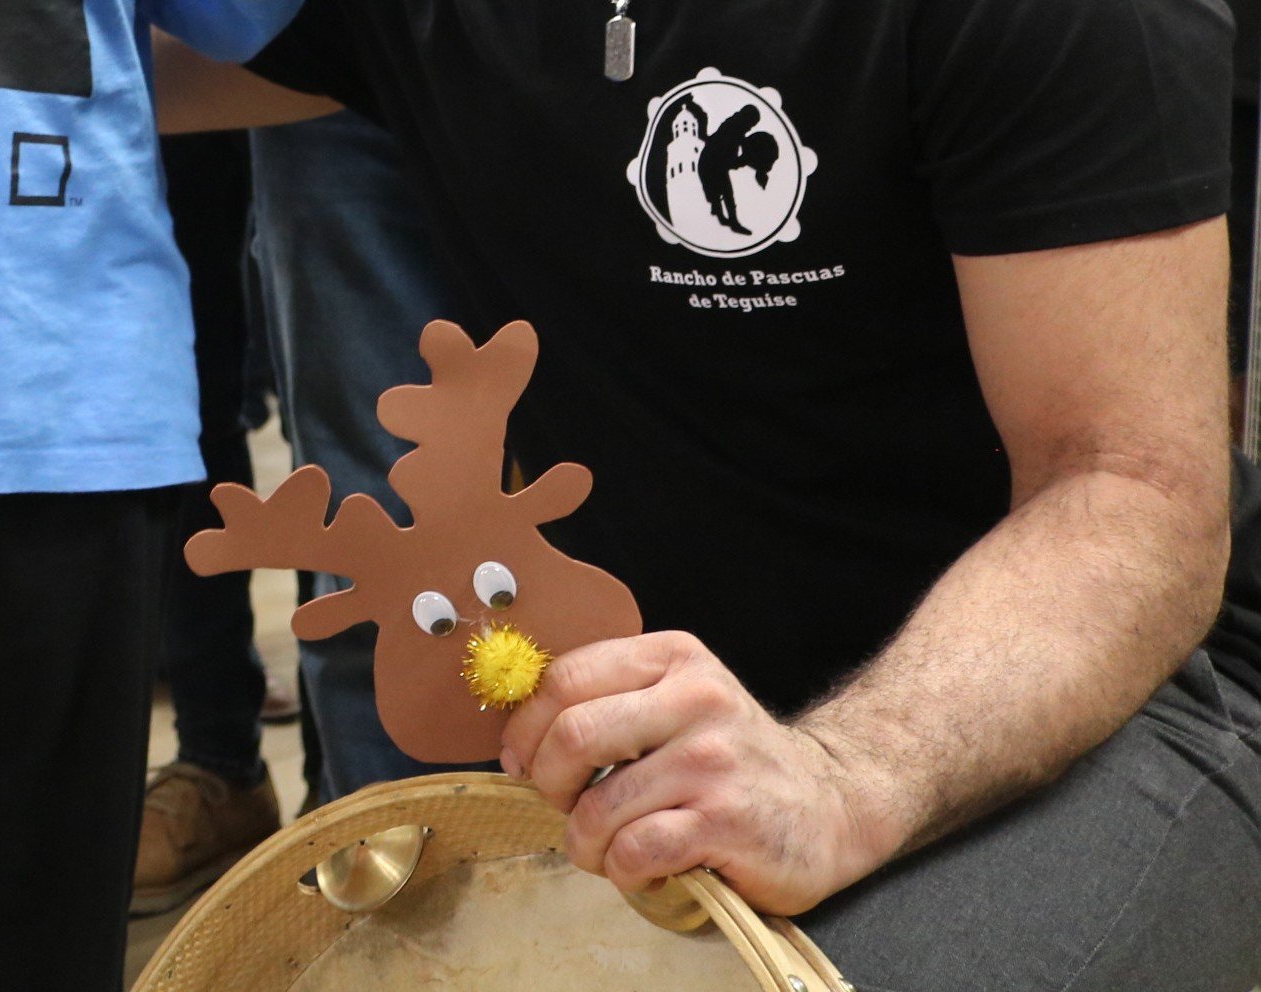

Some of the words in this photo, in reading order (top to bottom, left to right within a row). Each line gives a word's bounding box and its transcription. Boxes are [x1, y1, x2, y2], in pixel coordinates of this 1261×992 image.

[649, 265, 718, 287] Rancho
[721, 269, 747, 287] de
[749, 264, 846, 287] Pascuas
[688, 292, 712, 310] de
[712, 292, 798, 313] Teguise
